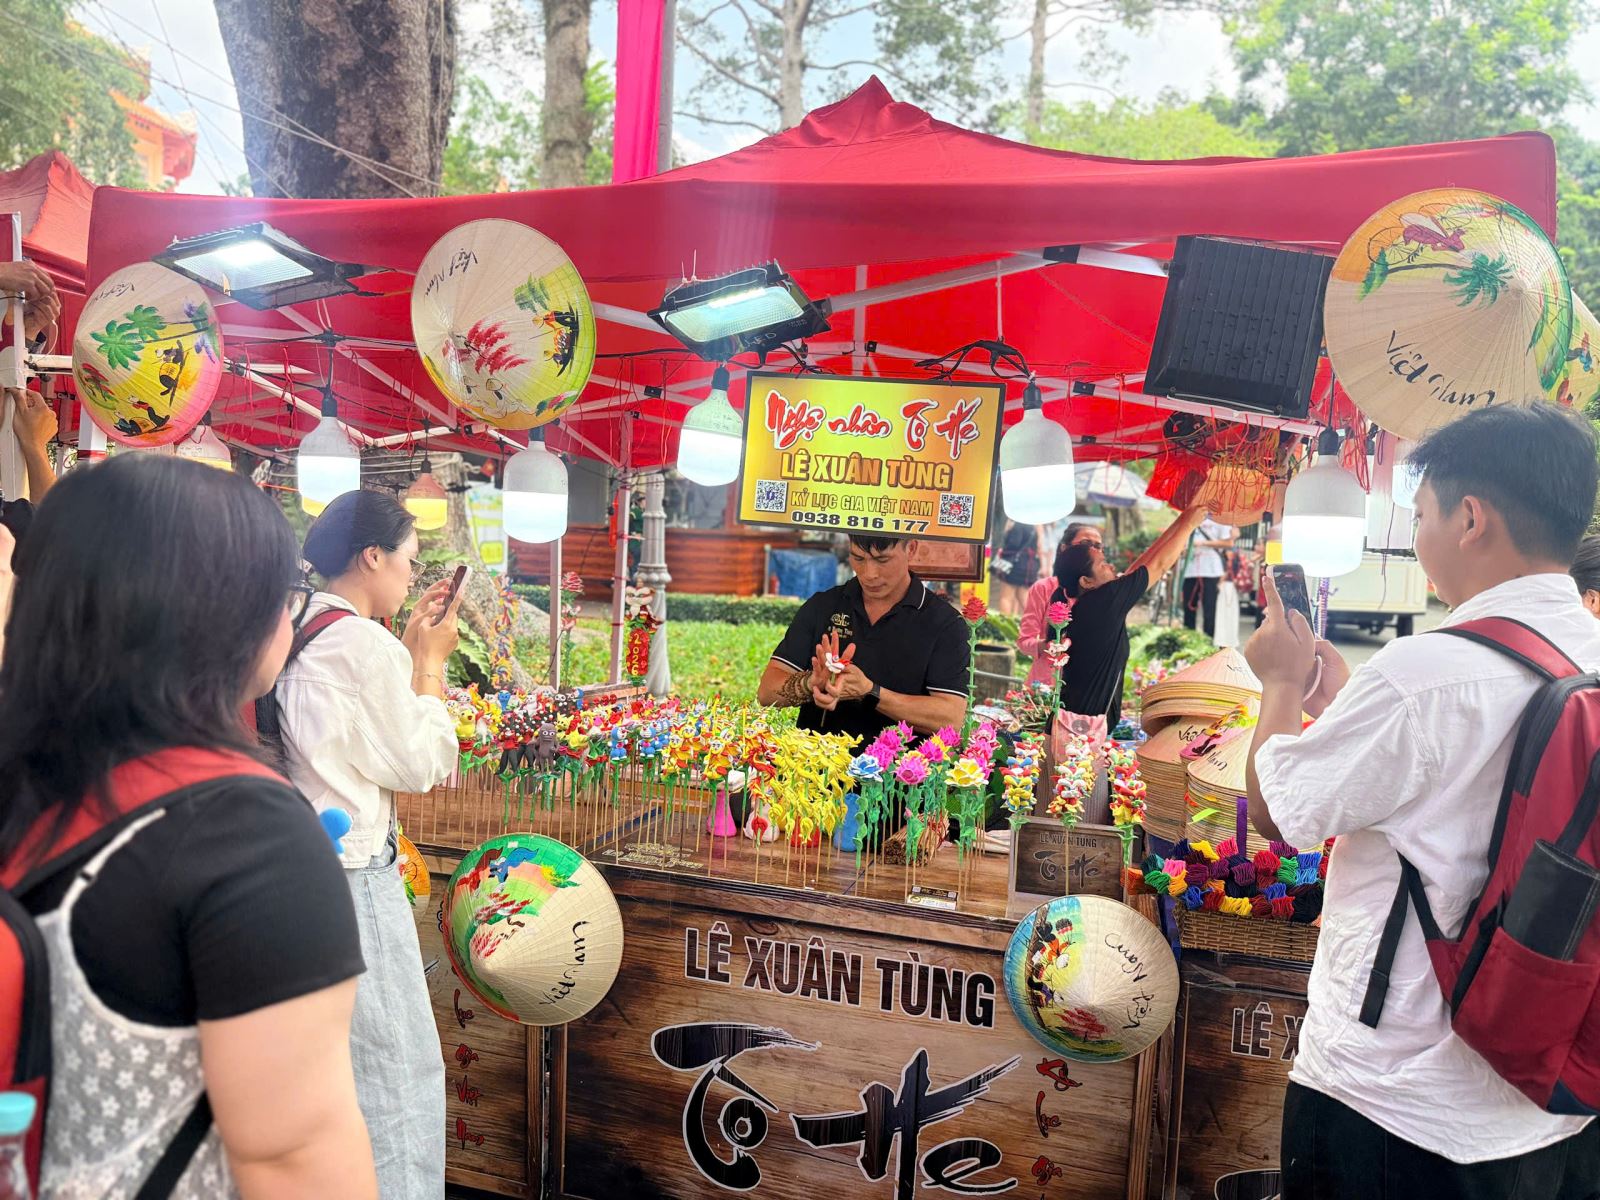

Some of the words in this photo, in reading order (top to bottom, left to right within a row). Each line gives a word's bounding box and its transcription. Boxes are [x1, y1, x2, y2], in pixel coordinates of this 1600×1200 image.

[766, 391, 825, 449] Nghệ
[828, 403, 892, 438] nhân
[780, 449, 811, 480] LÊ
[813, 453, 882, 486] XUÂN
[886, 456, 953, 491] TÙNG
[791, 487, 809, 506] KỶ
[811, 492, 837, 510] LỤC
[840, 496, 865, 512] GIA
[867, 495, 897, 517] VIỆT
[900, 500, 933, 517] NAM
[791, 511, 841, 526] 0938
[846, 516, 884, 530] 816
[893, 519, 930, 533] 177
[631, 632, 642, 676] 2026
[684, 921, 731, 985] LÊ
[743, 936, 863, 1006] XUÂN
[873, 951, 997, 1029] TÙNG
[1231, 1002, 1274, 1059] LÊ
